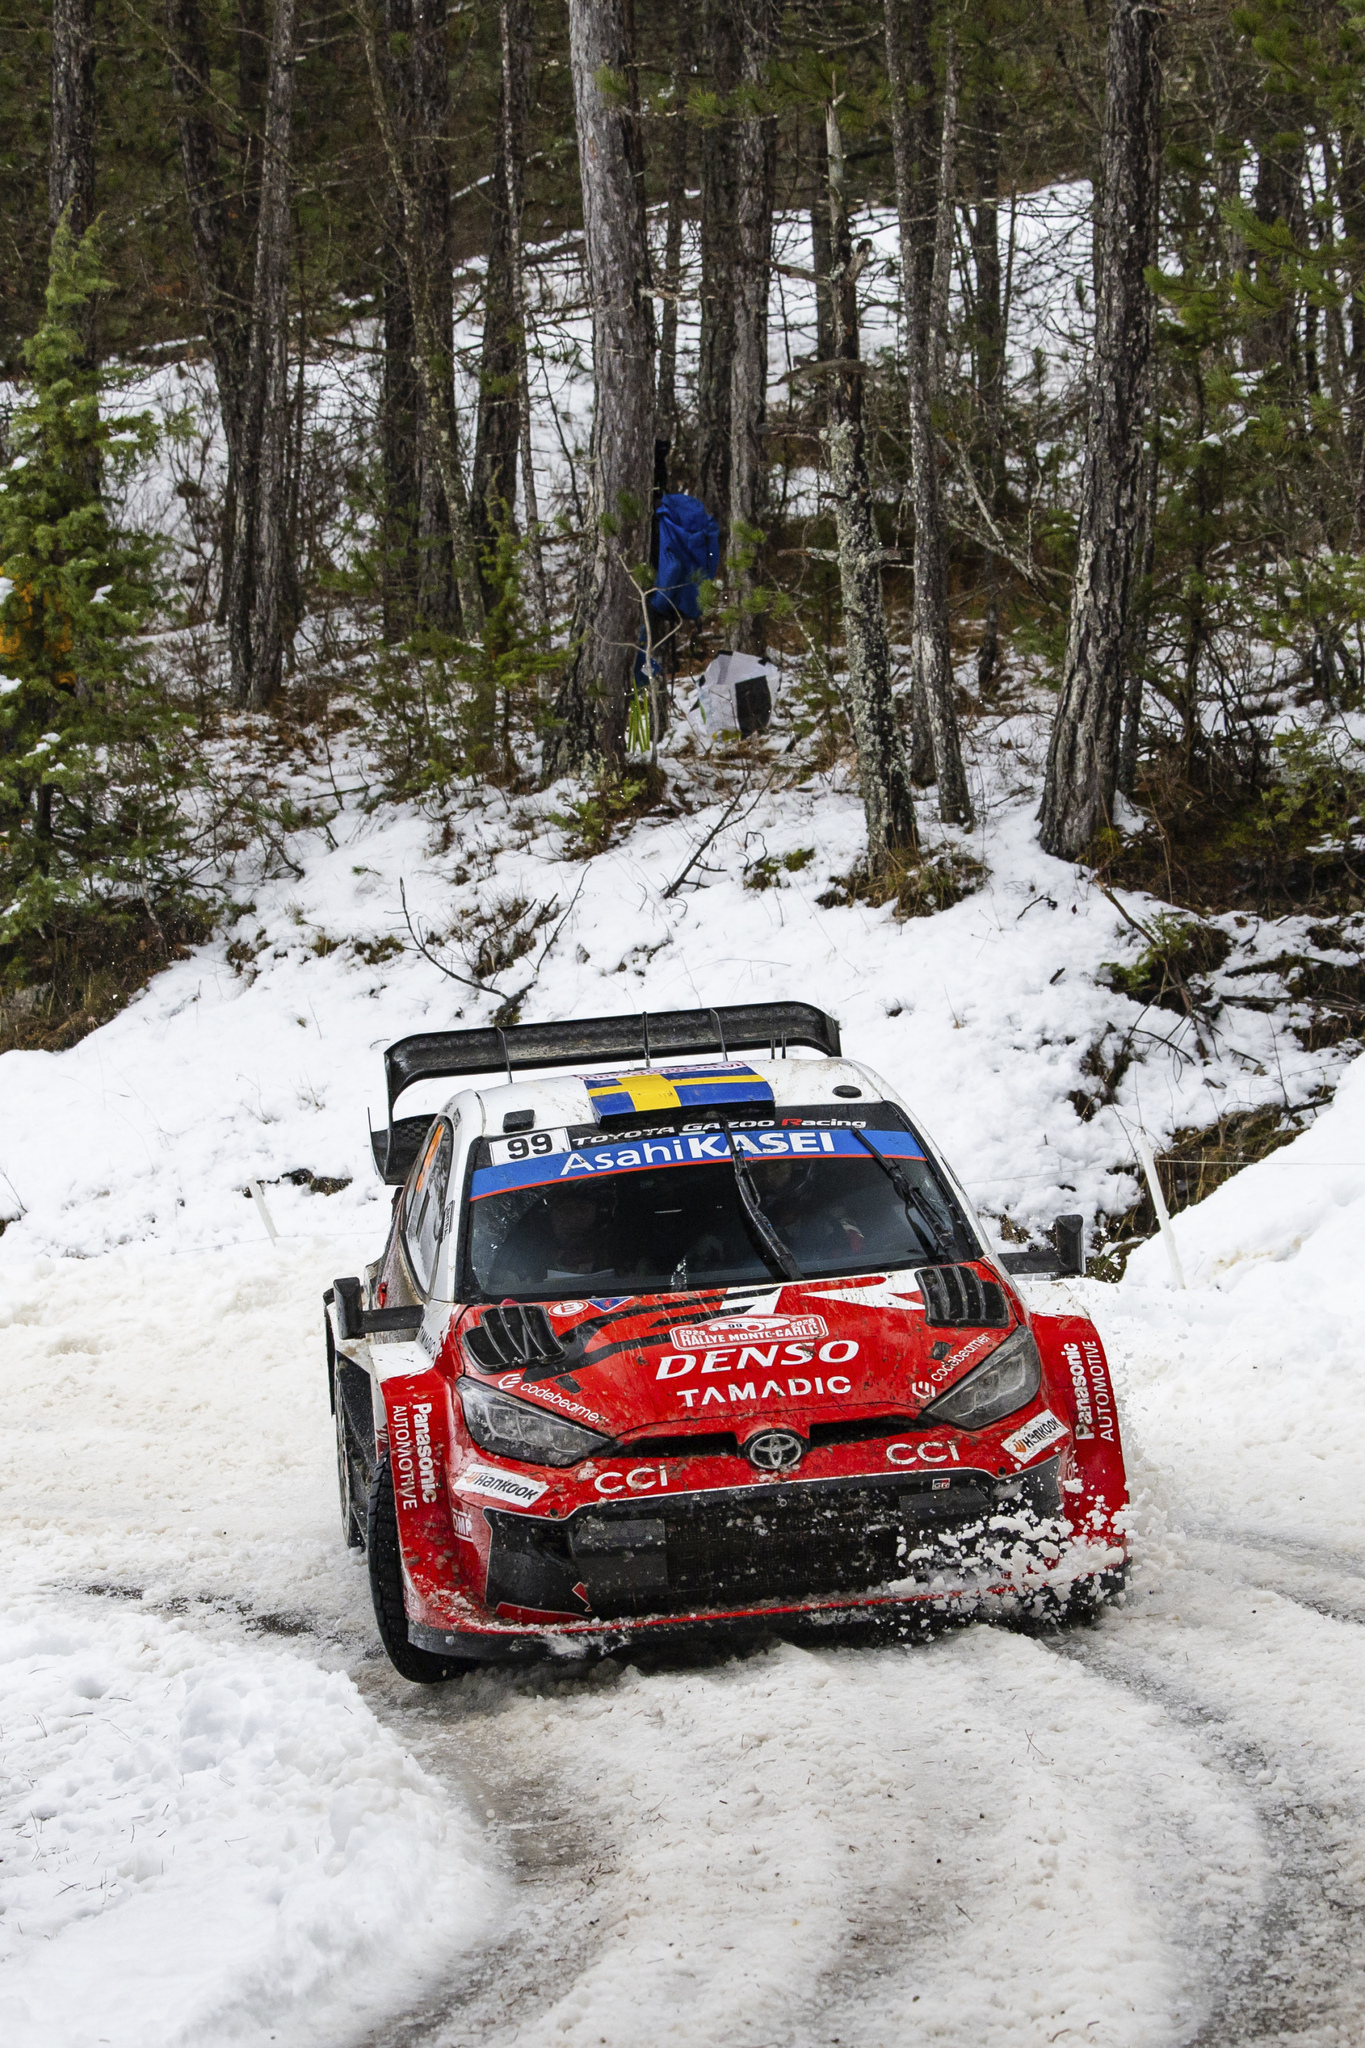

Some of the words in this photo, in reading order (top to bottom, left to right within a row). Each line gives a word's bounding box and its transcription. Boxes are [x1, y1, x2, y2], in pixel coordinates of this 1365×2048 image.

[507, 1133, 553, 1160] 99
[572, 1126, 675, 1146] TOYOTA
[682, 1119, 775, 1132] GAZOO
[781, 1117, 867, 1129] Racing
[680, 1333, 726, 1347] RALLYE
[730, 1323, 820, 1342] MONTE-CARLO
[930, 1332, 991, 1382] codebeamer
[655, 1340, 860, 1380] DENSO
[676, 1376, 852, 1408] TAMADIC
[1061, 1342, 1095, 1440] Panasonic
[1082, 1340, 1115, 1442] AUTOMOTIVE
[392, 1405, 418, 1510] AUTOMOTIVE
[412, 1402, 437, 1504] Panasonic
